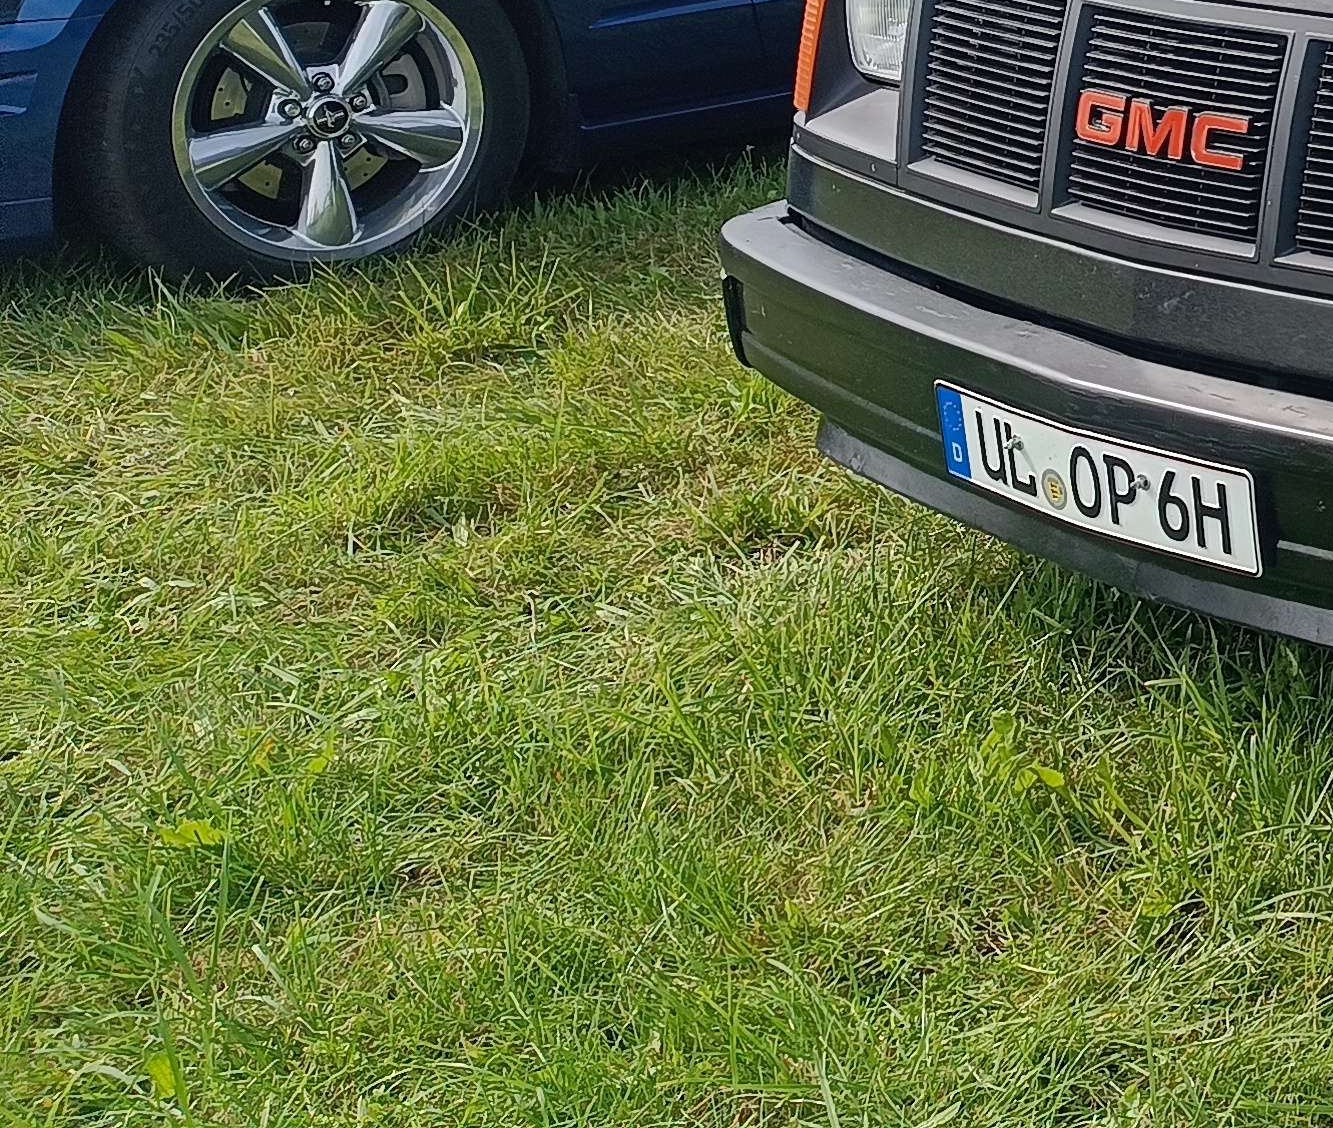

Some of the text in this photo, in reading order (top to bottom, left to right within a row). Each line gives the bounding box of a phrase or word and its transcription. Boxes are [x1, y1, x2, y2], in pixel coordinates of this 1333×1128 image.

[1075, 87, 1252, 171] GMC
[951, 442, 963, 463] D
[975, 410, 1232, 556] UL OP 6H
